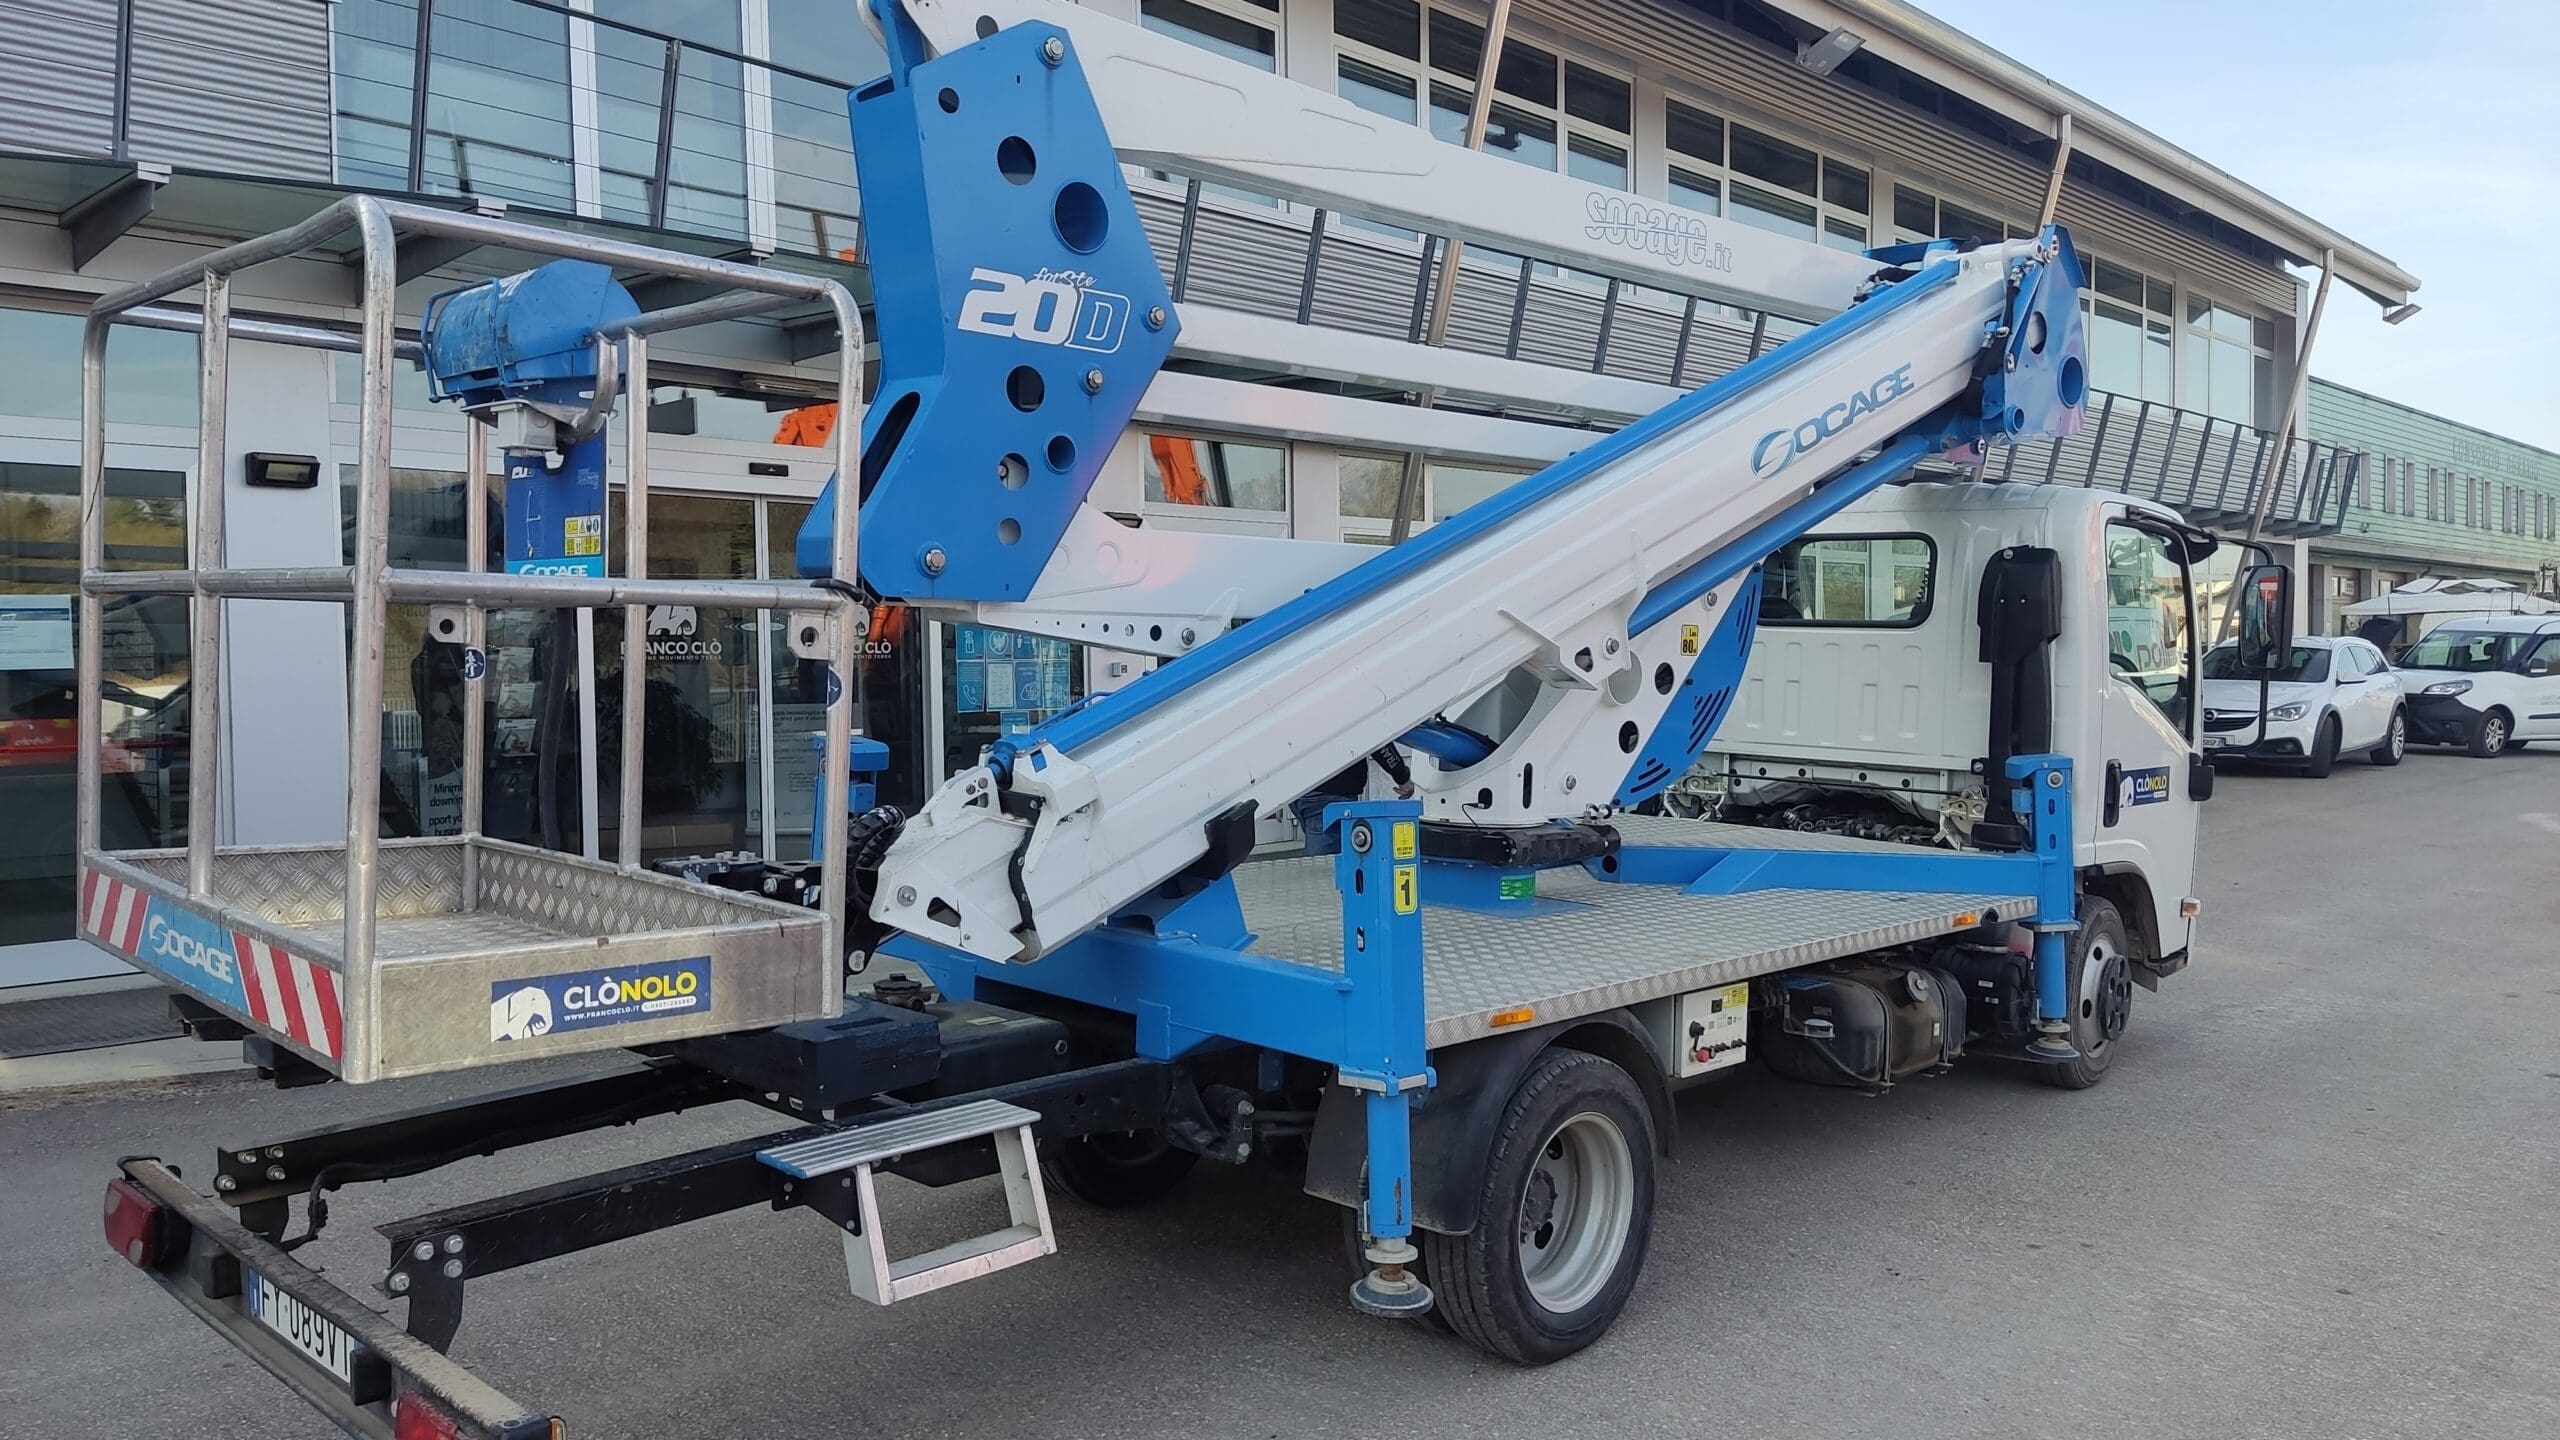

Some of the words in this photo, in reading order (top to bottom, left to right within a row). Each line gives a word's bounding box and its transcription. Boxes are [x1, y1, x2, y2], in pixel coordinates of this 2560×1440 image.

[957, 267, 1132, 354] 20D
[1750, 362, 1916, 480] SOCAGE
[691, 637, 722, 655] CLÒ
[865, 638, 892, 654] CLÒ
[149, 914, 234, 985] SOCAGE
[563, 971, 697, 1009] CLÒNOLO
